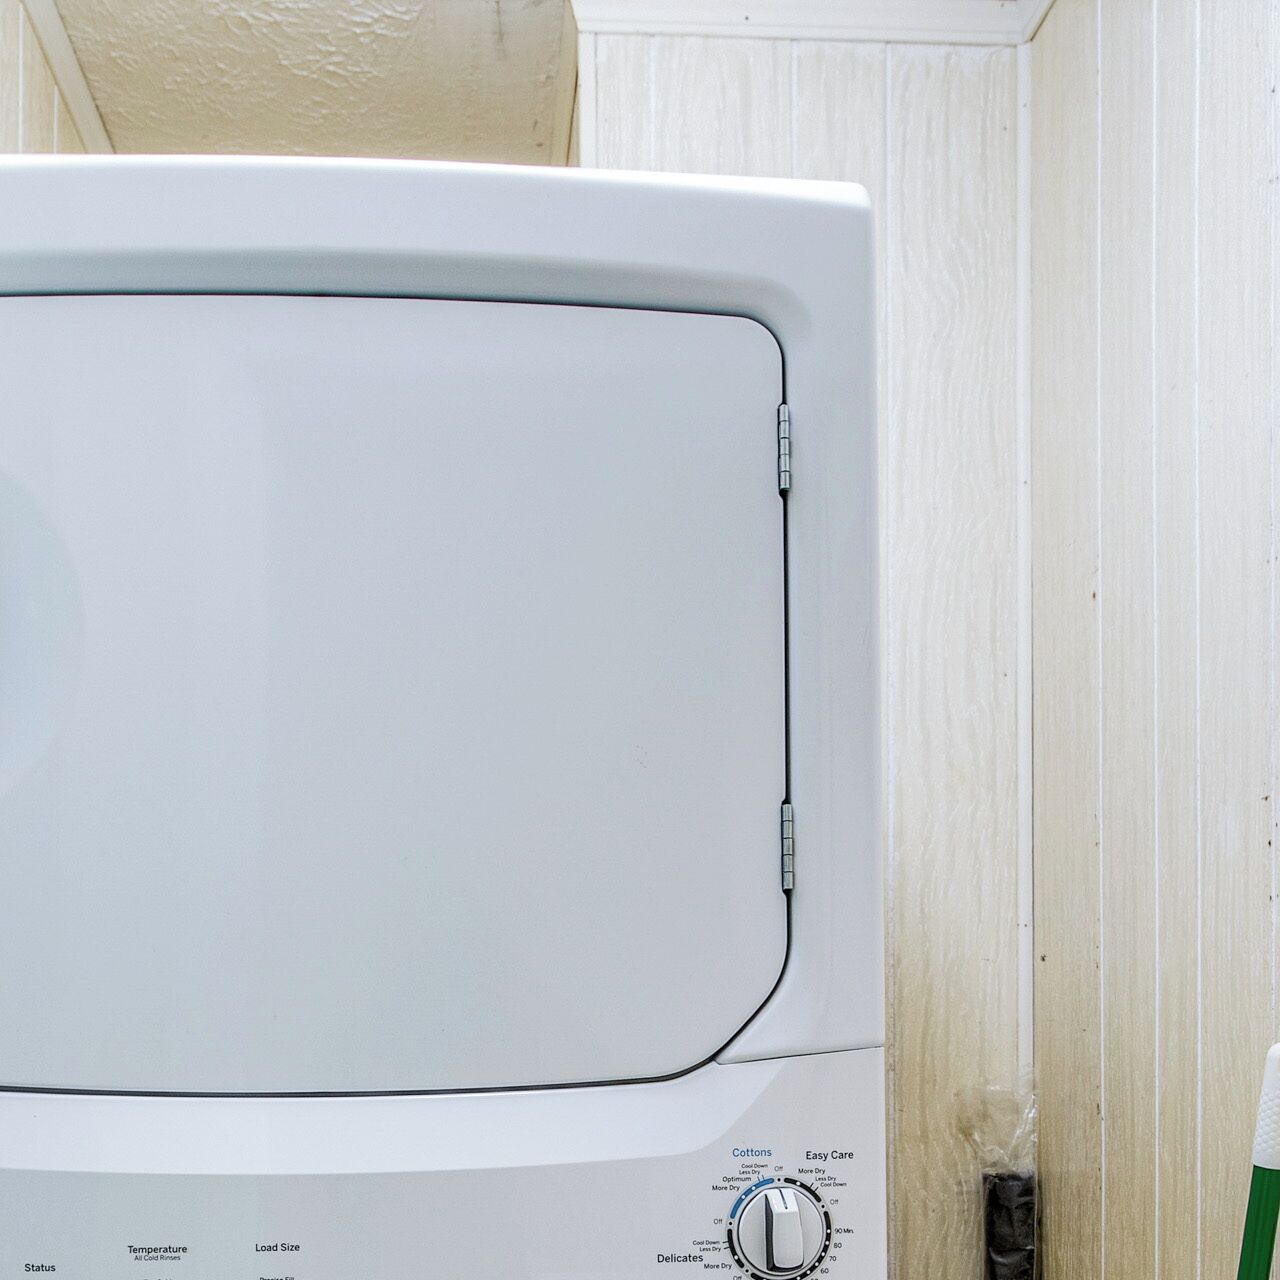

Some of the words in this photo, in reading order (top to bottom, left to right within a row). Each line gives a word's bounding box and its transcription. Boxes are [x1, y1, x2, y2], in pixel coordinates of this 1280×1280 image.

[732, 1148, 772, 1157] Cottons
[806, 1151, 828, 1161] Easy
[831, 1150, 854, 1159] Care
[128, 1245, 187, 1255] Temperature
[255, 1243, 278, 1252] Load
[280, 1243, 300, 1251] Size
[657, 1253, 704, 1263] Delicates
[24, 1263, 56, 1272] Status
